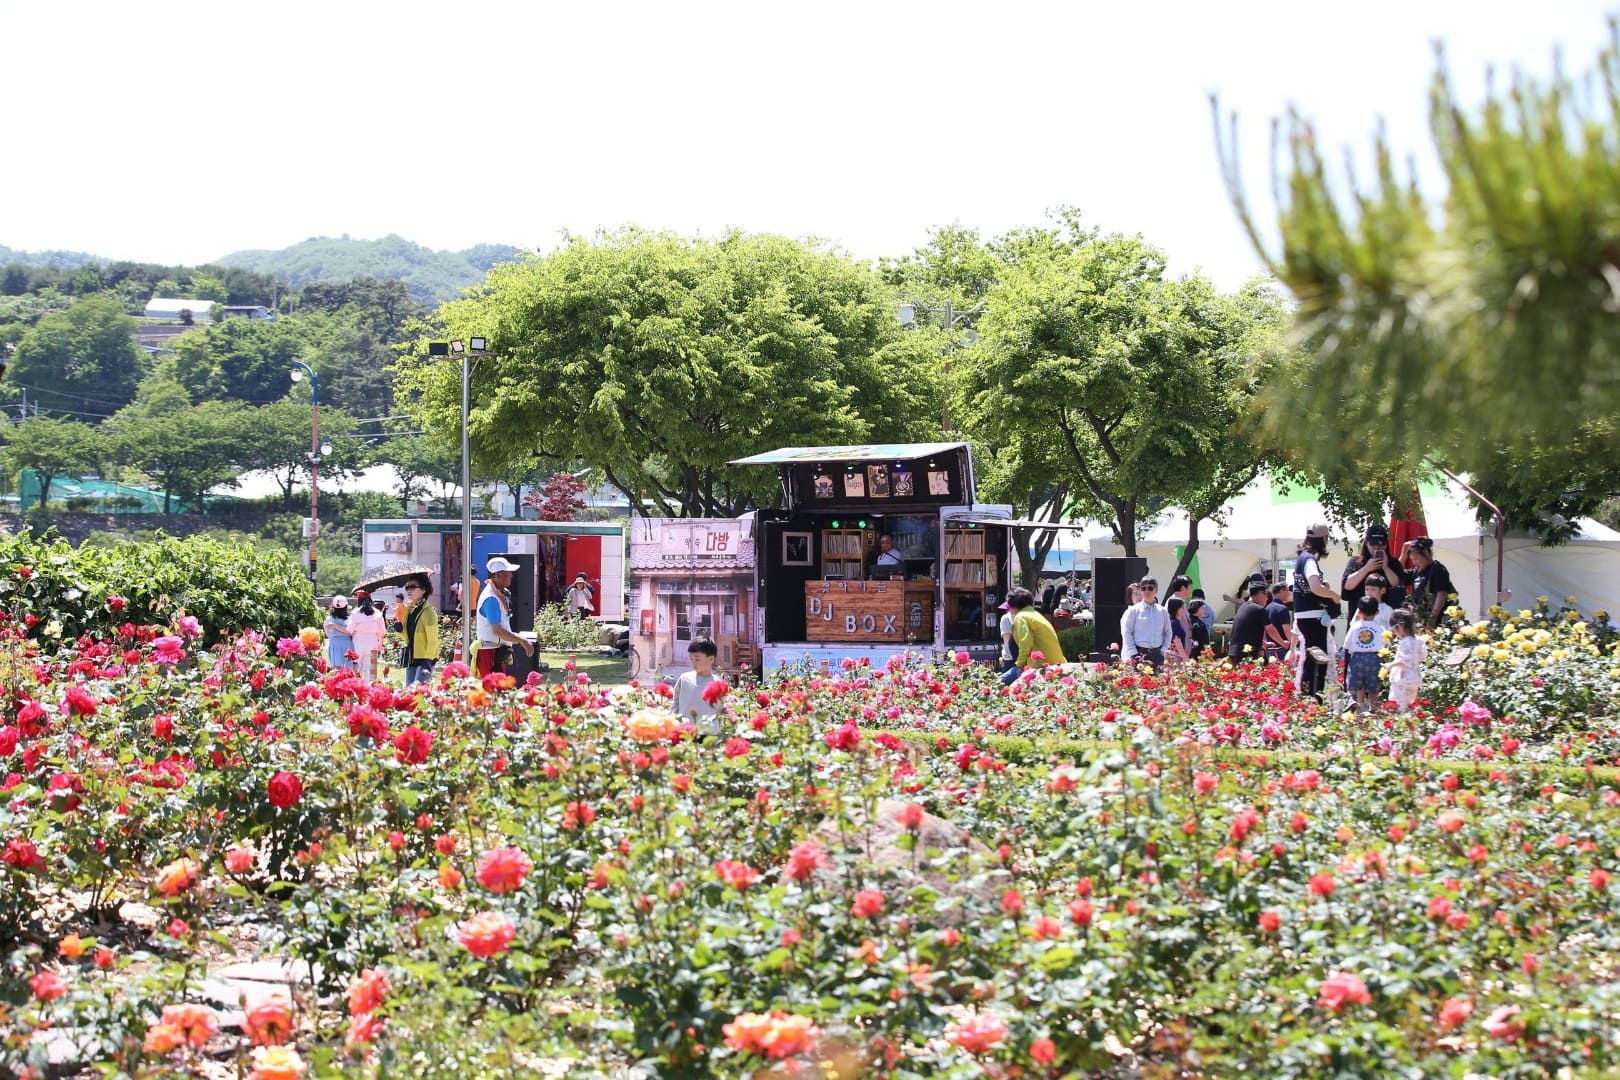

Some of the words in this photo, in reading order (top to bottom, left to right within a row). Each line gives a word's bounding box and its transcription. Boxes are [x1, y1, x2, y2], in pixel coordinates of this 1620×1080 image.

[706, 531, 730, 552] 다방
[810, 596, 834, 621] DJ
[845, 614, 897, 634] BOX
